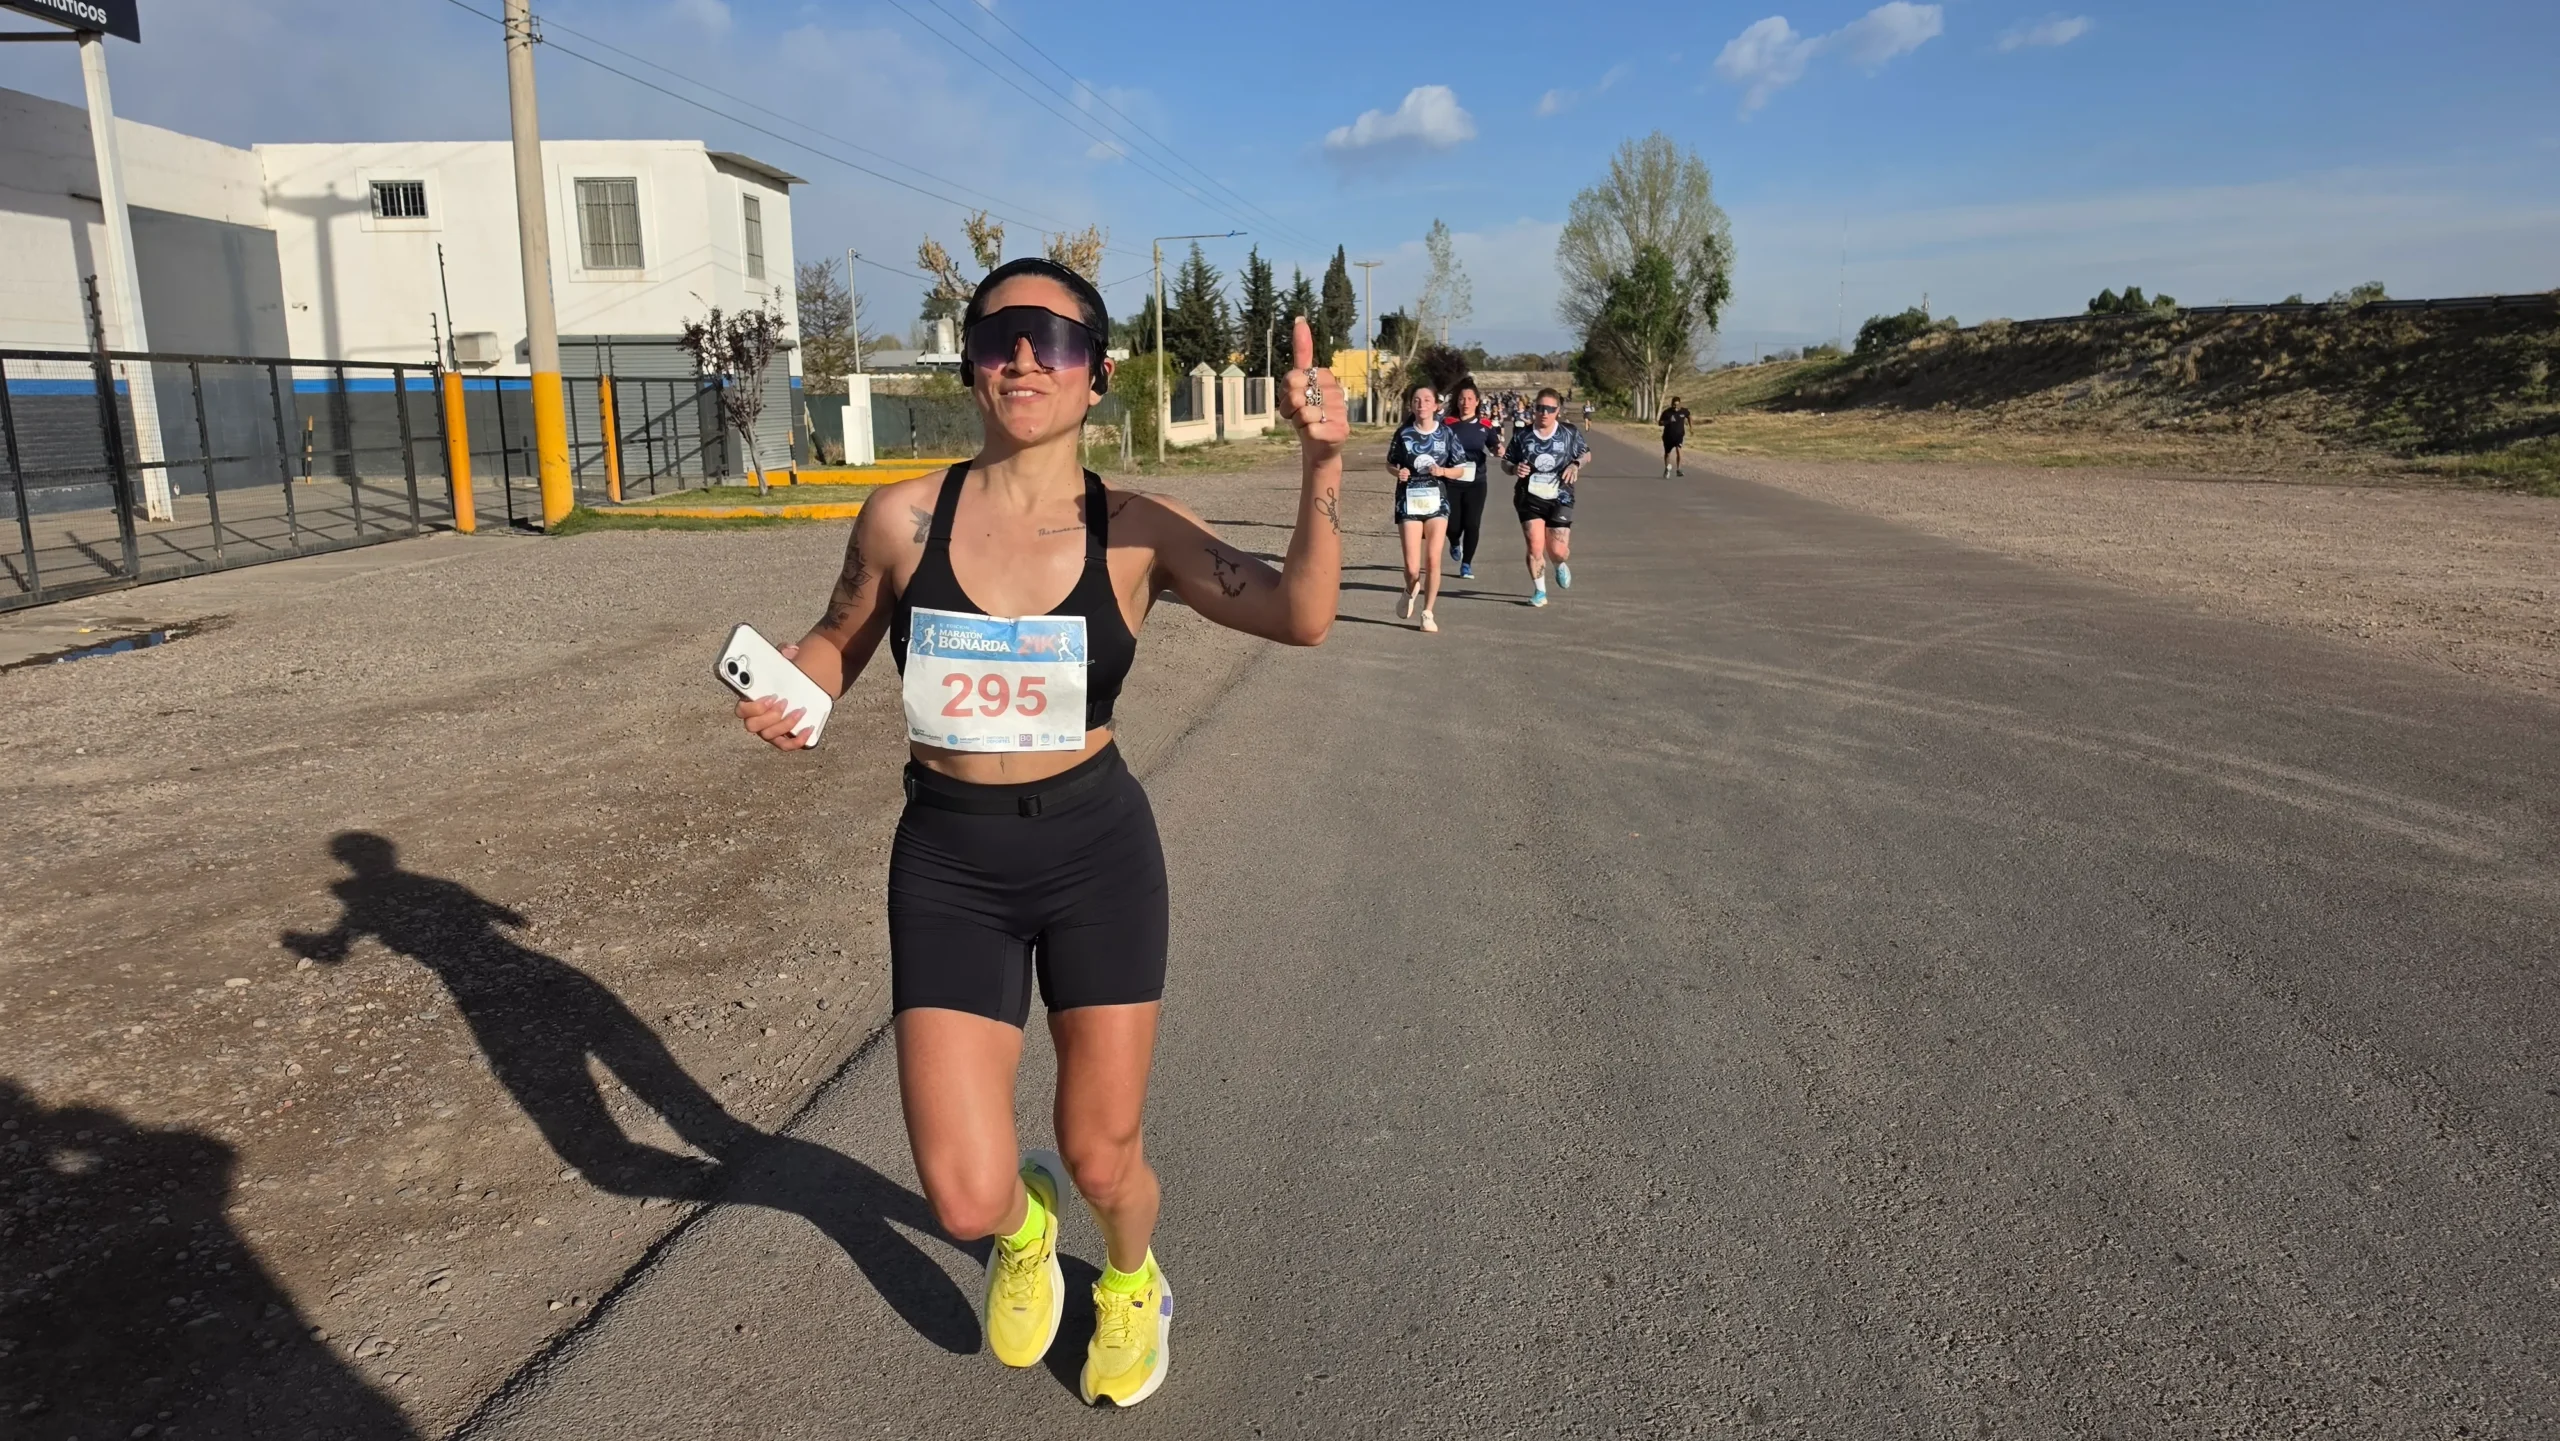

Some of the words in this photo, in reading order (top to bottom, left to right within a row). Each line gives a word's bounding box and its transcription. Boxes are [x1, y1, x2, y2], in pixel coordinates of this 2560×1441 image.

[34, 0, 107, 24] aticos
[938, 636, 1012, 653] BONARDA
[939, 629, 983, 640] MARATÓN
[940, 673, 1048, 718] 295
